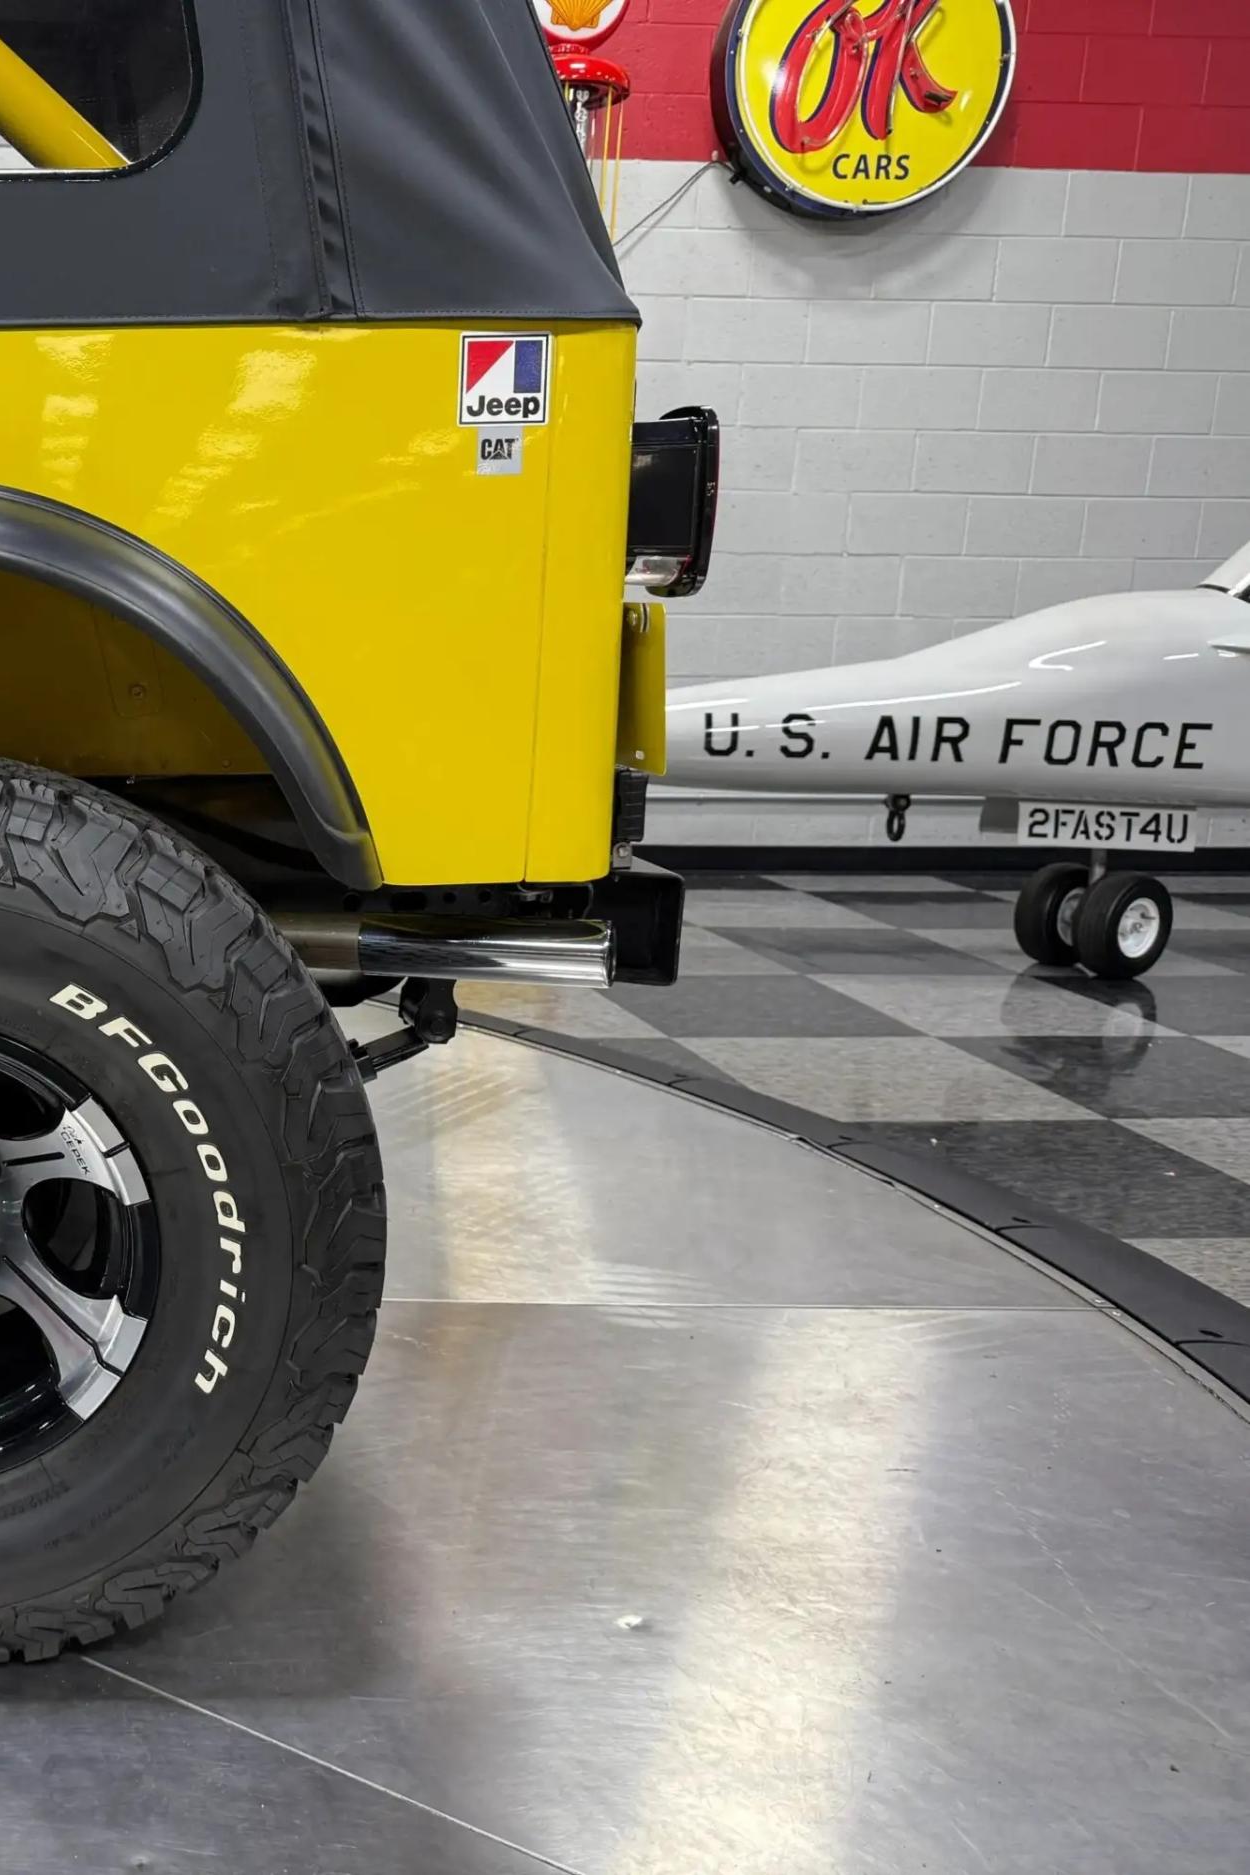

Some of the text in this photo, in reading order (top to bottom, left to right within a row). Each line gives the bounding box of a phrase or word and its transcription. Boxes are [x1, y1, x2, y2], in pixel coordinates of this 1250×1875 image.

[769, 0, 958, 154] OK
[832, 153, 910, 180] CARS
[466, 395, 541, 418] Jeep
[480, 438, 516, 461] CAT
[865, 715, 970, 763] AIR
[998, 718, 1213, 770] FORCE
[1027, 807, 1189, 845] 2FAST4U
[49, 982, 247, 1395] BFGoodrich
